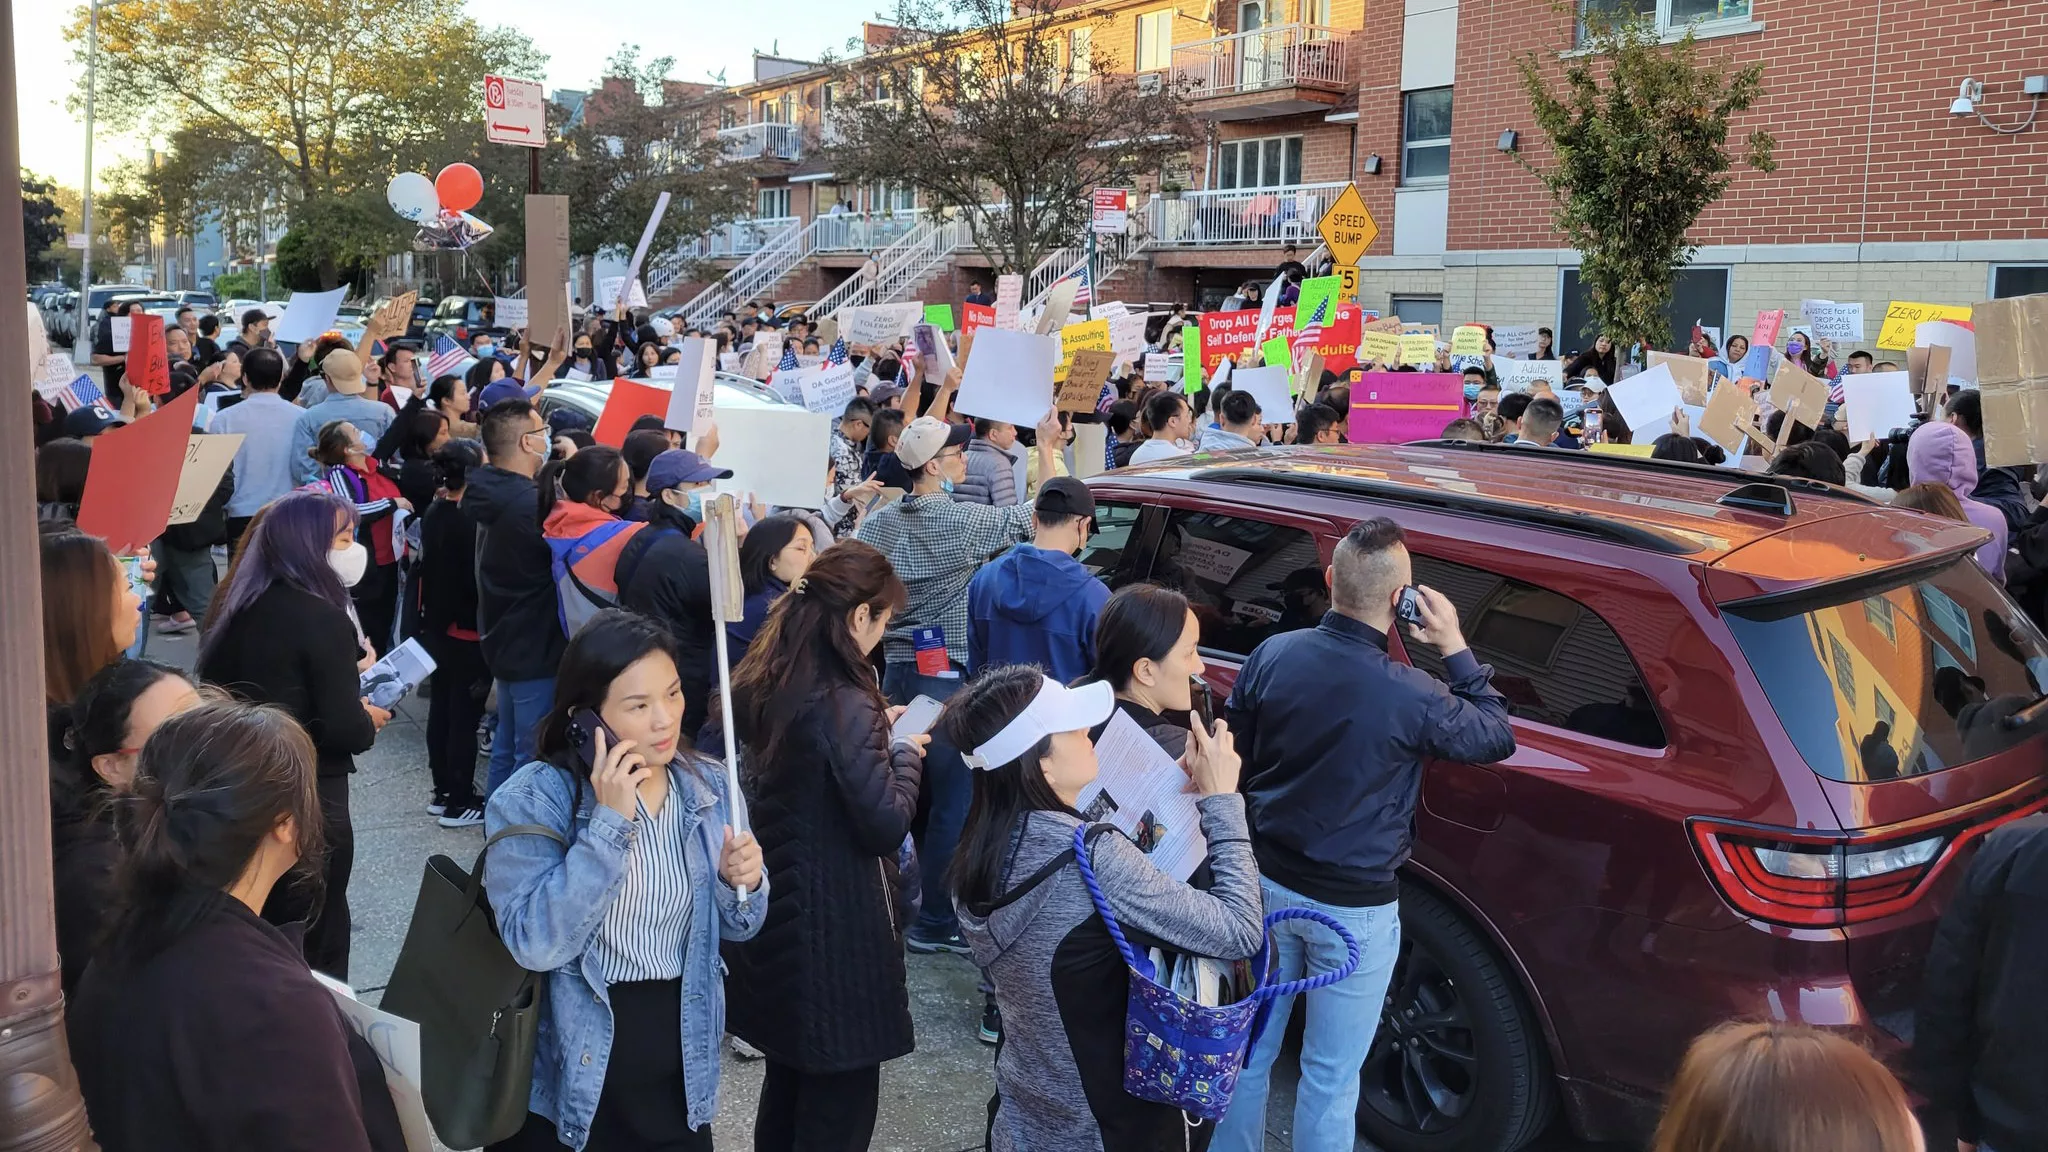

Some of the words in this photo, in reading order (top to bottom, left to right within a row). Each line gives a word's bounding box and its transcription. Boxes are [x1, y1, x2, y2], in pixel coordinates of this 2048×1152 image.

[1333, 213, 1365, 229] SPEED
[1334, 231, 1362, 245] BUMP
[873, 315, 894, 323] ZERO
[977, 311, 994, 326] Room
[1887, 306, 1922, 321] ZERO
[1209, 317, 1233, 331] Drop
[1234, 314, 1249, 327] All
[1895, 323, 1905, 334] to
[1207, 333, 1223, 347] Self
[1521, 362, 1549, 375] Adults
[812, 380, 824, 389] DA
[93, 406, 109, 420] C
